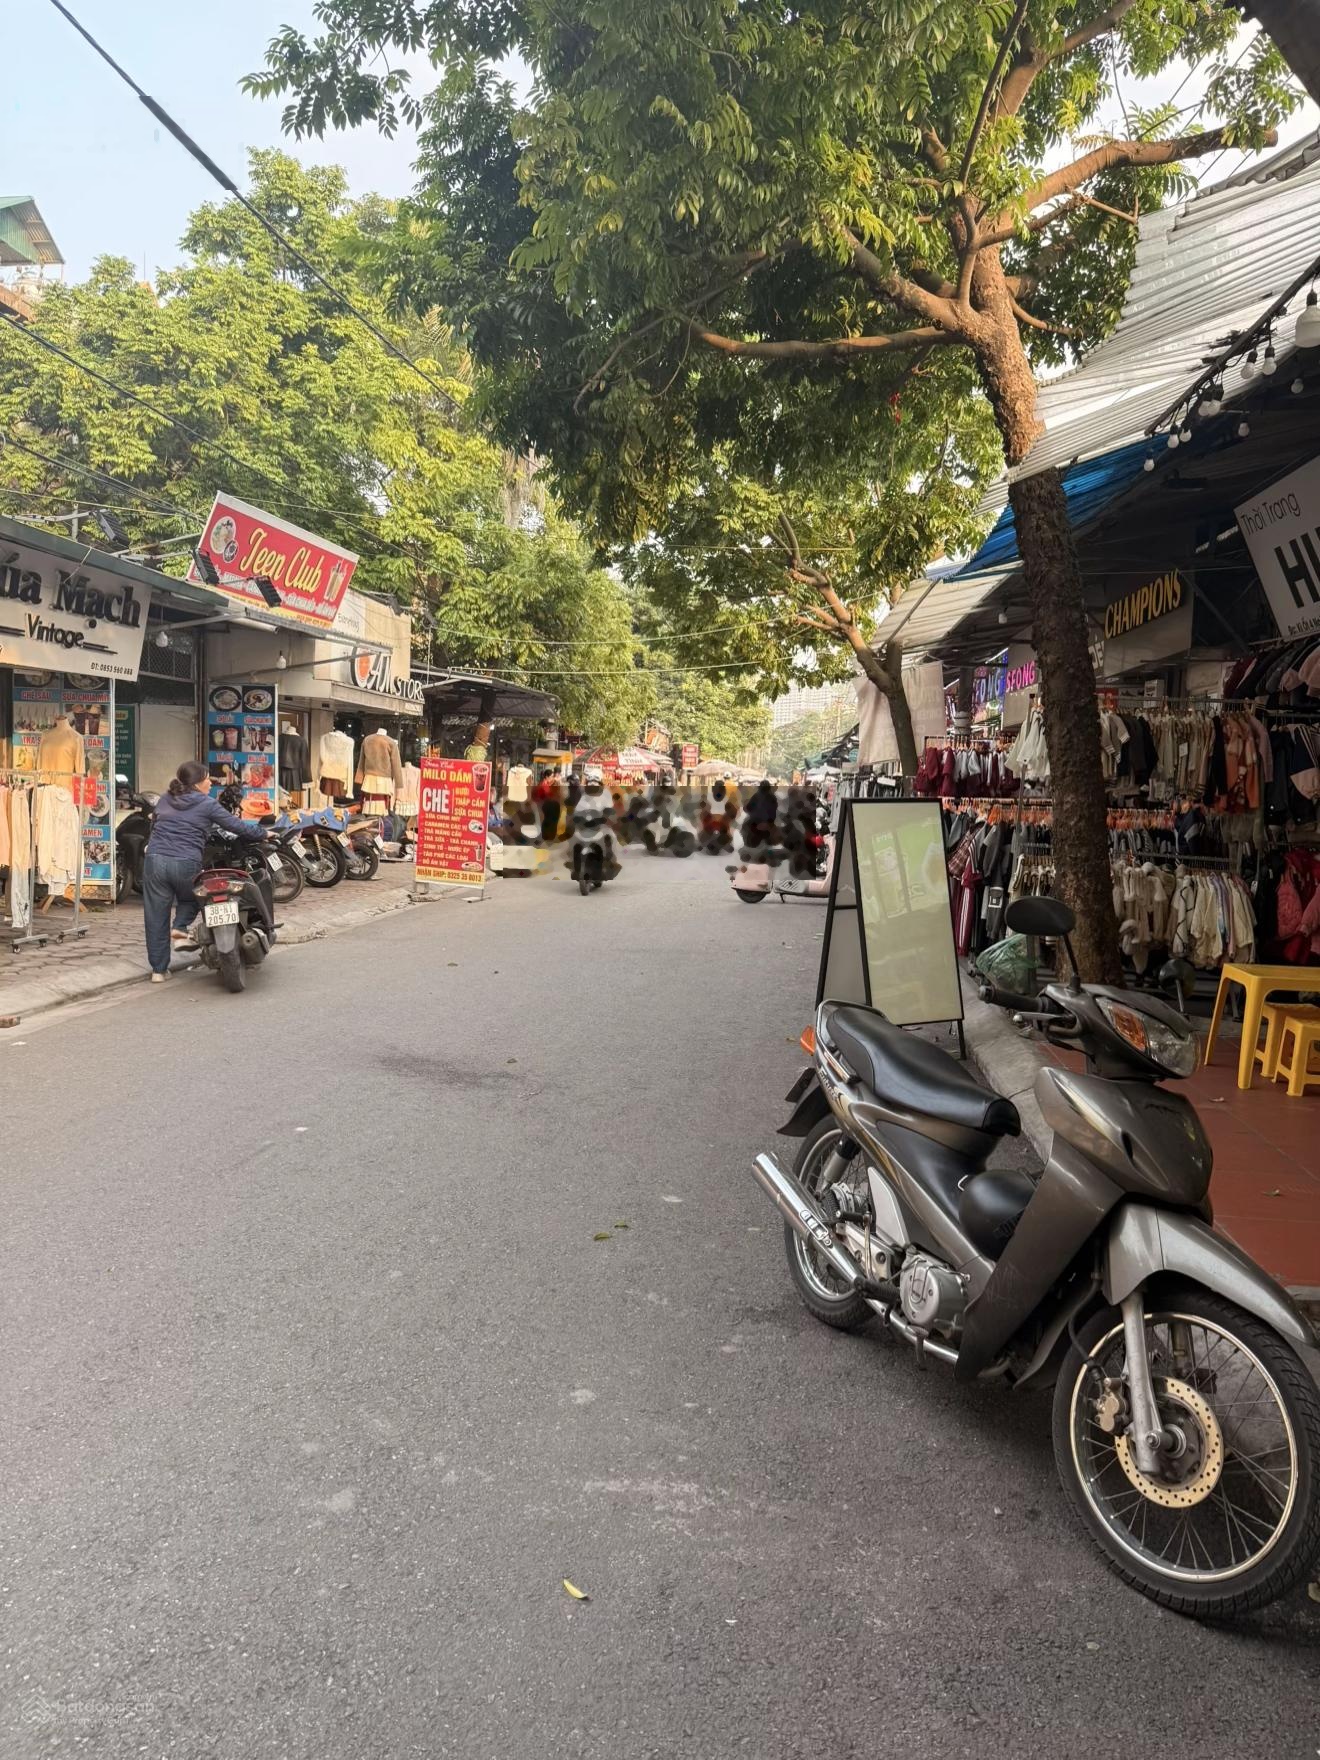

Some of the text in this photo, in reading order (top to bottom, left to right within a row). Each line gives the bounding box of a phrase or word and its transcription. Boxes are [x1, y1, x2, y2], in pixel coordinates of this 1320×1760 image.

[1240, 492, 1301, 536] Thời Trang
[239, 527, 286, 581] Teen
[284, 546, 324, 593] Club
[49, 569, 141, 629] Mạch
[1104, 567, 1182, 640] CHAMPIONS
[25, 612, 84, 649] Vintage
[1006, 660, 1036, 693] SFONG
[423, 767, 447, 781] MILO
[422, 783, 450, 814] CHÈ
[454, 806, 483, 818] SỮA CHUA
[207, 913, 237, 926] 205.70
